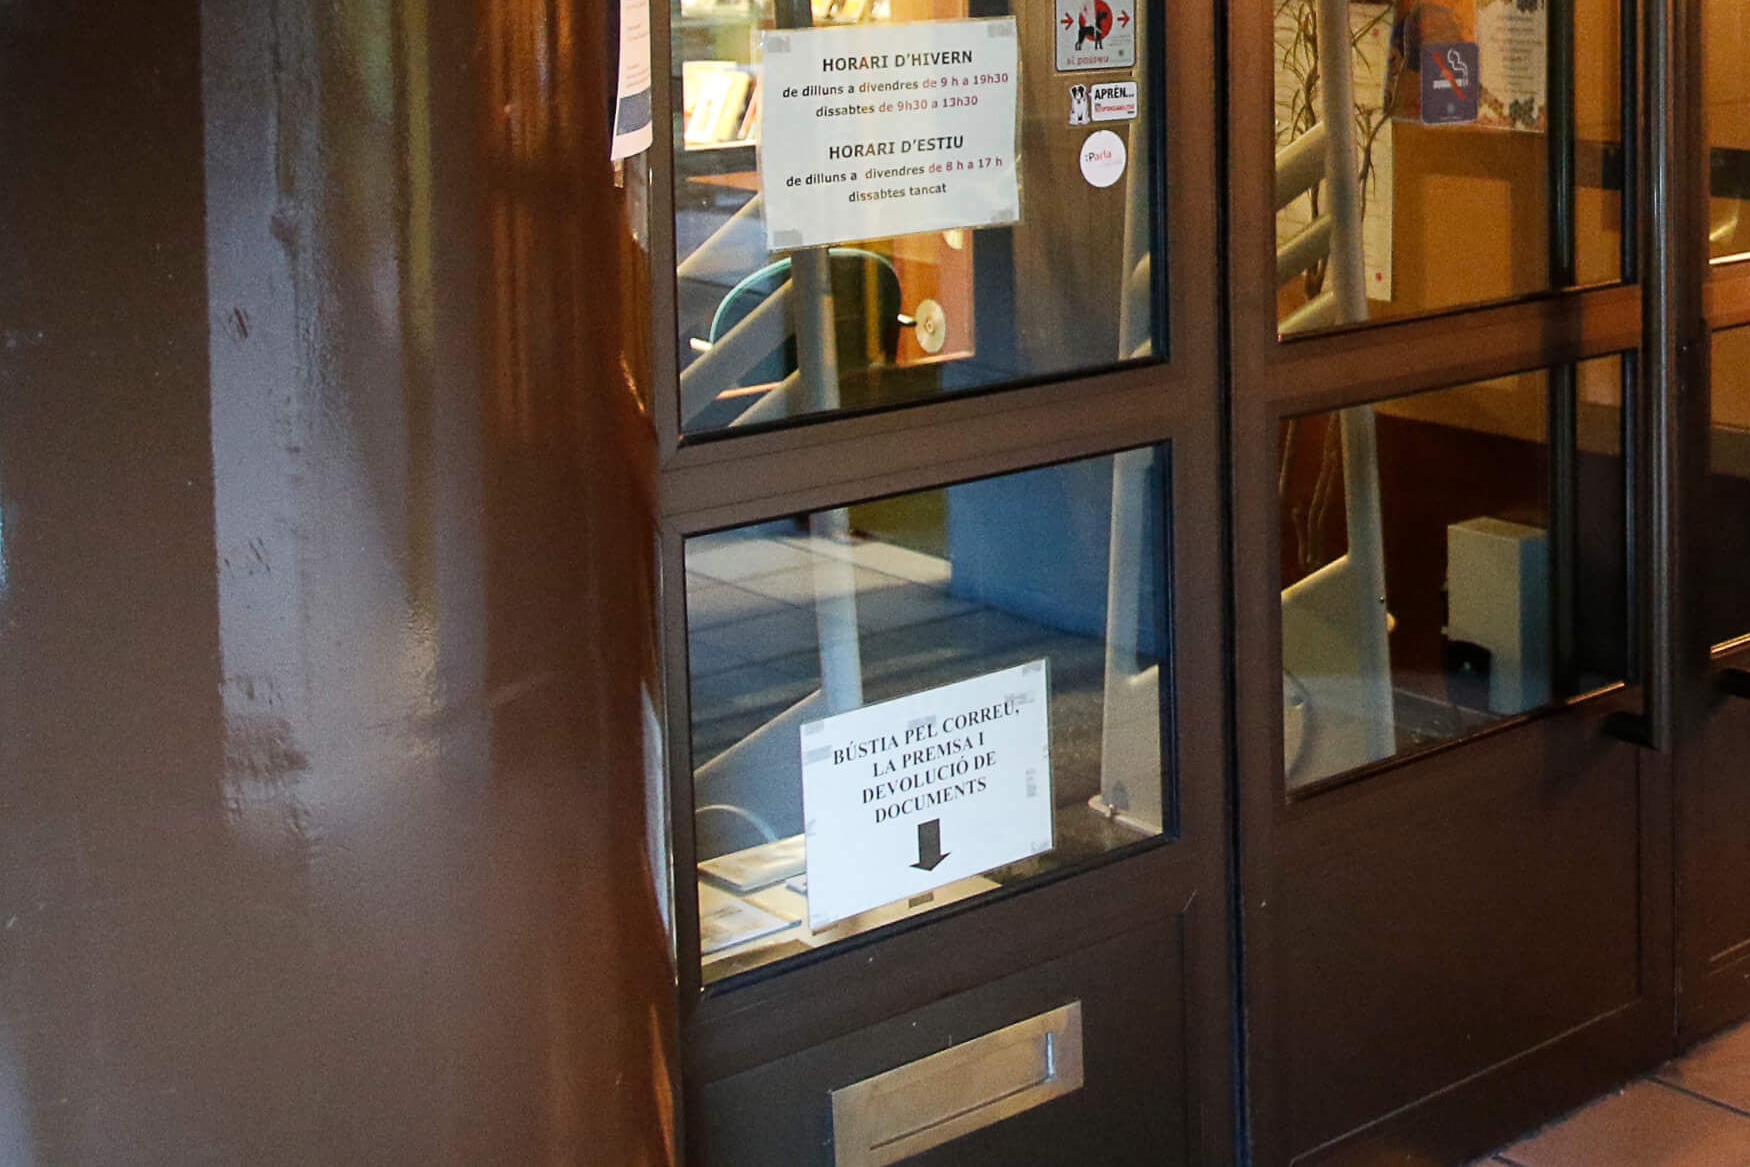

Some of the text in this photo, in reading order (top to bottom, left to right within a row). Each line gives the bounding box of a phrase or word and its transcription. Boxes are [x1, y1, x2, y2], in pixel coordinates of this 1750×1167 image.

[823, 50, 973, 72] HORARI D'HIVERN
[782, 73, 1009, 98] de dilluns a divendres de 9 h a 19h30
[815, 95, 978, 117] dissabtes de 9h30 a 13h30
[829, 135, 964, 160] HORARI D'ESTIU
[786, 157, 1002, 188] de dilluns a divendres de 8 h a 17 h
[849, 183, 947, 202] dissabtes tancat
[833, 700, 1020, 765] BÚSTIA PEL CORREU,
[873, 731, 985, 778] LA PREMSA I
[862, 751, 997, 804] DEVOLUCIÓ DE
[875, 776, 987, 824] DOCUMENTS
